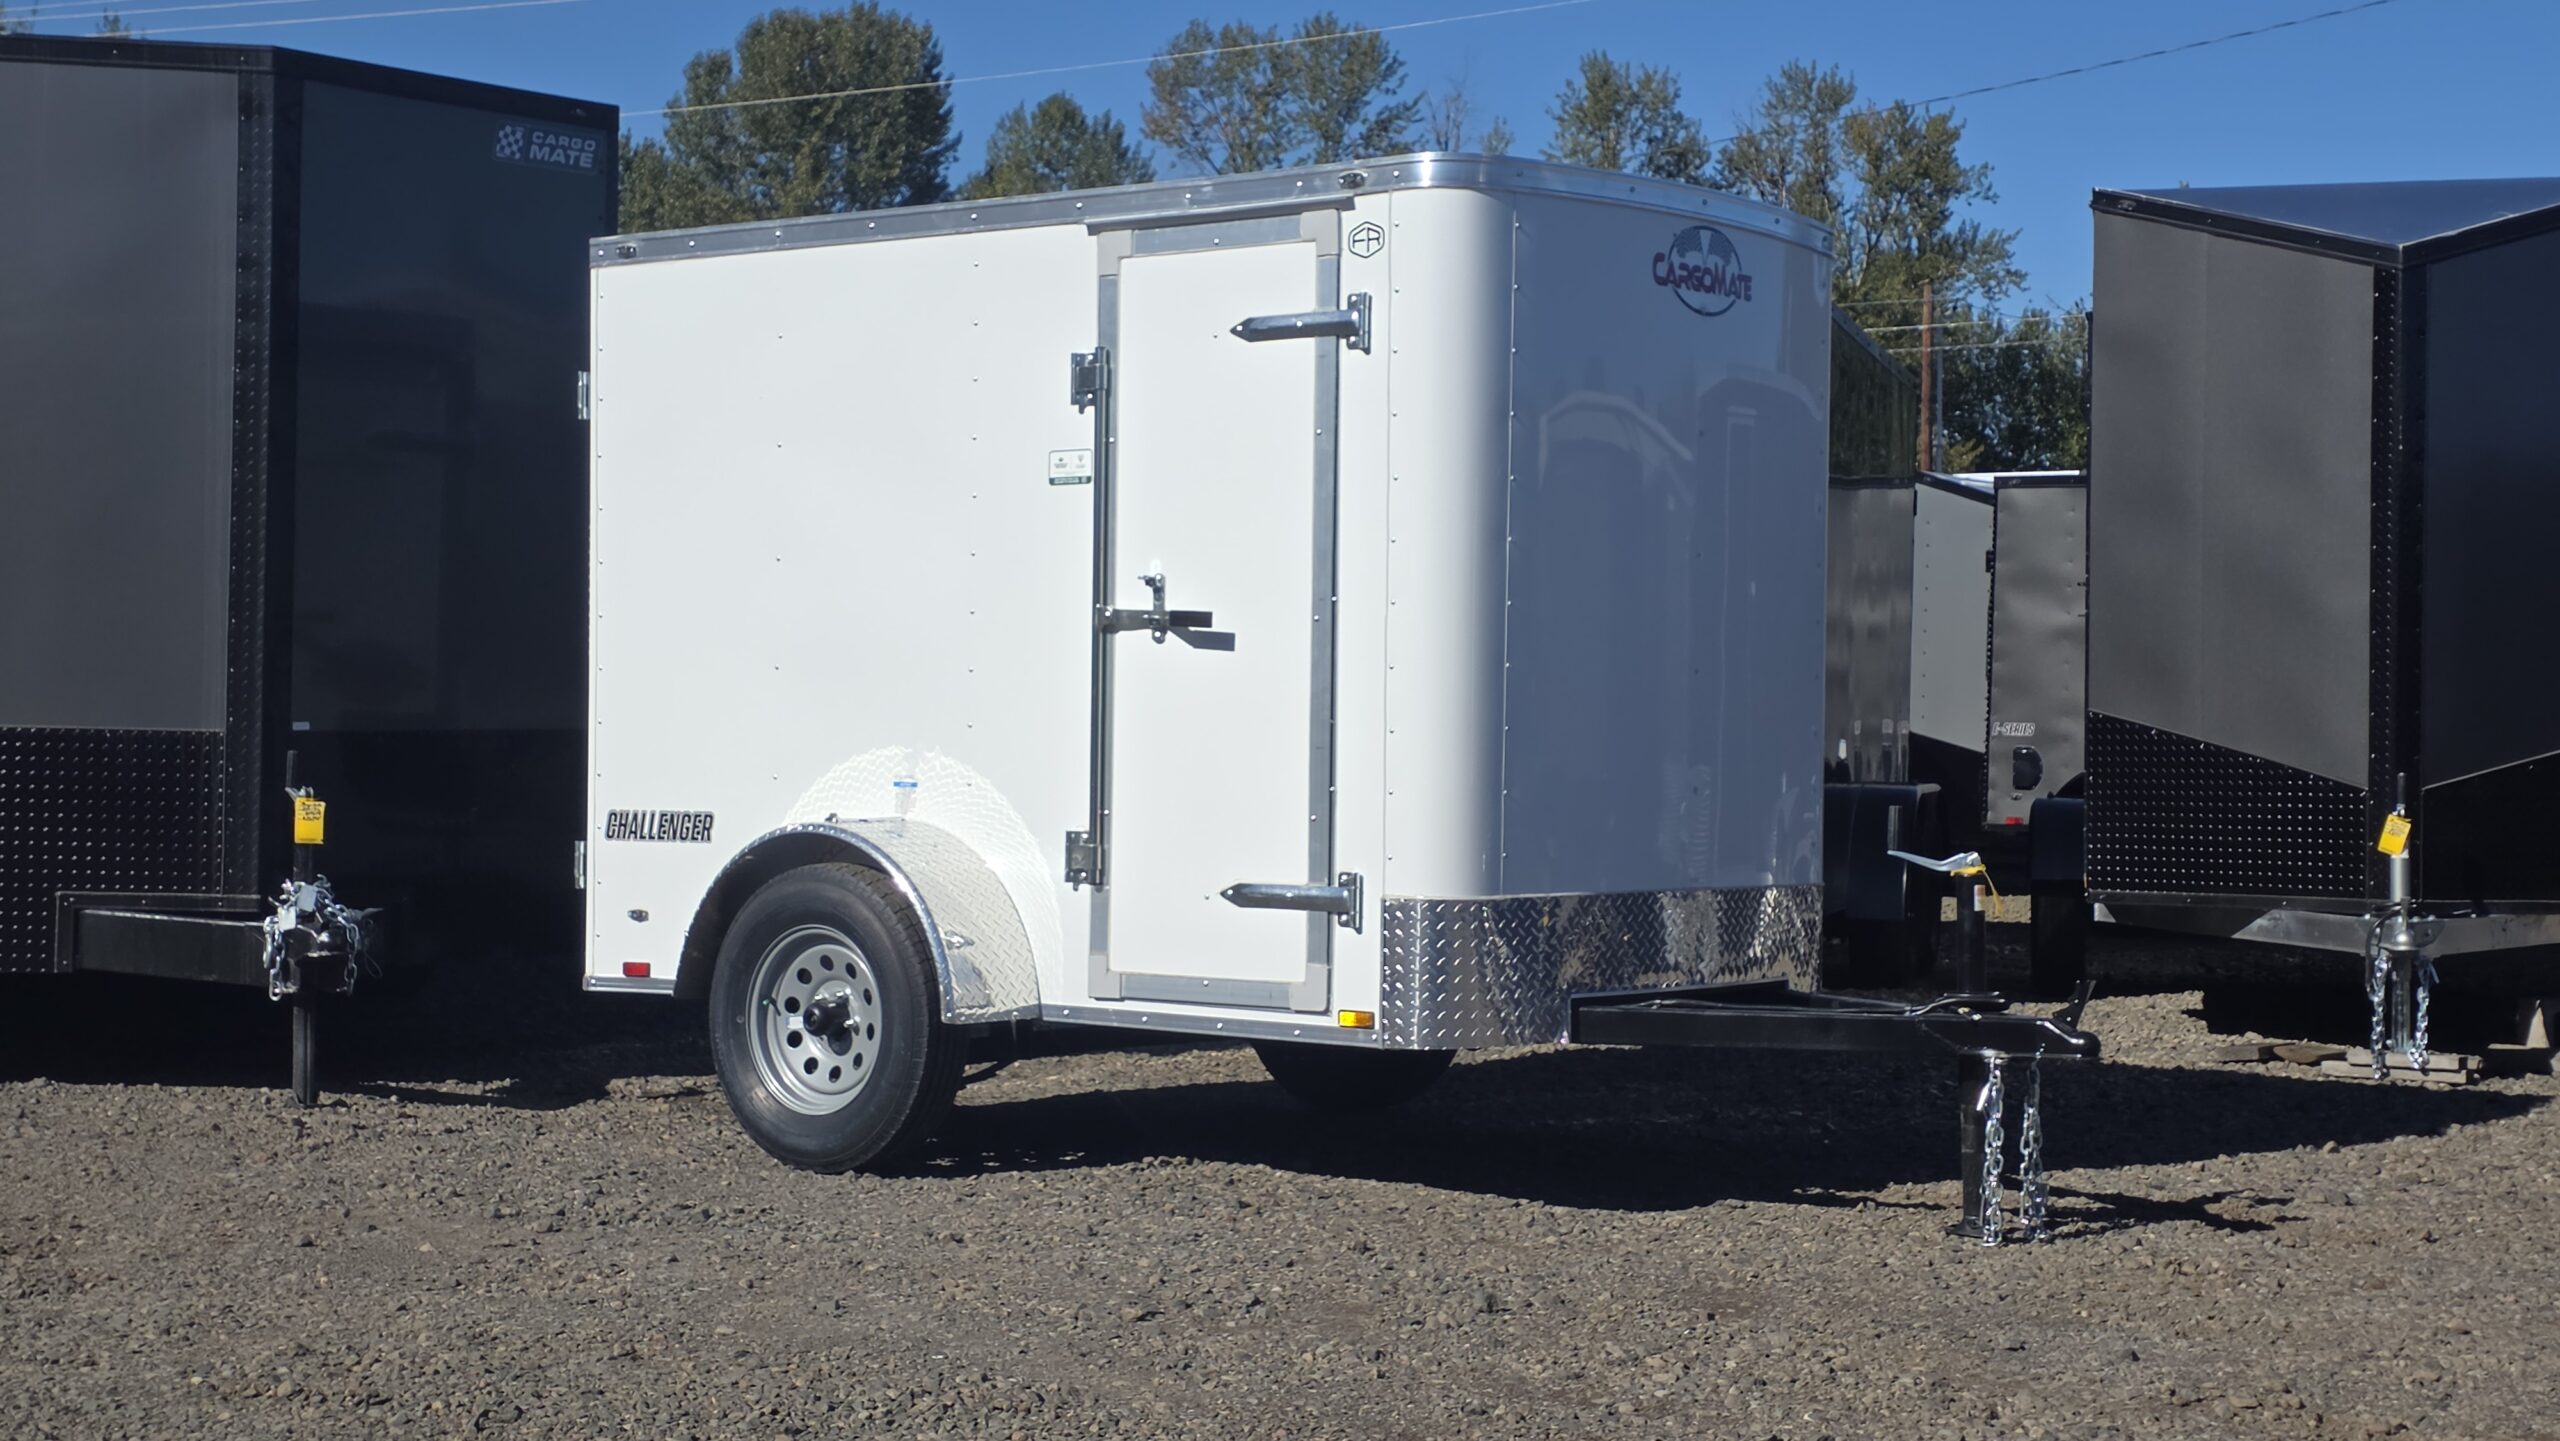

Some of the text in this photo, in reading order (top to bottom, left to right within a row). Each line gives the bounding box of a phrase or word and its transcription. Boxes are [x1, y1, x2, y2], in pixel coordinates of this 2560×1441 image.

[532, 131, 597, 151] CARGO
[529, 144, 595, 168] MATE
[606, 809, 714, 844] CHALLENGER
